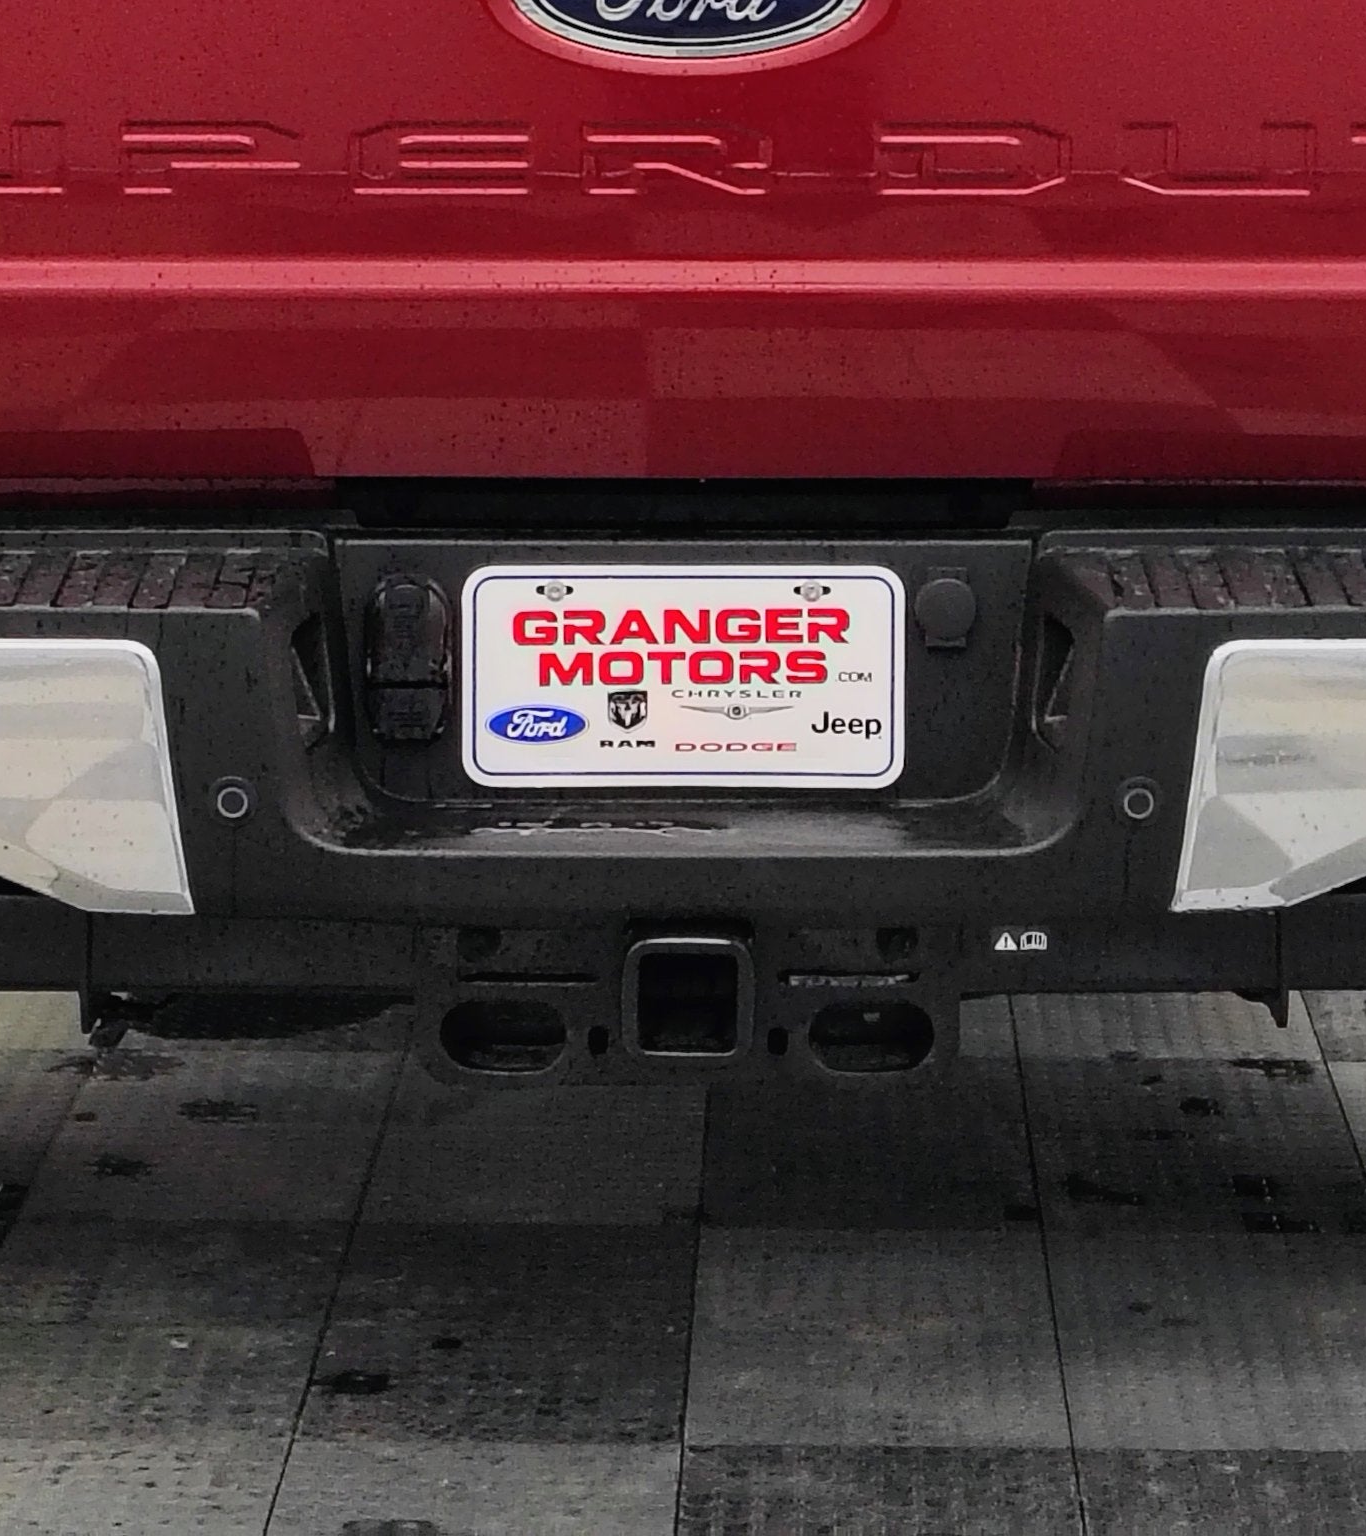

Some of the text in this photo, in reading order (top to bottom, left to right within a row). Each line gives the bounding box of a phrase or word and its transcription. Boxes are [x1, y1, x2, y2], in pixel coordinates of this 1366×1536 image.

[512, 609, 849, 645] GRANGER
[539, 651, 827, 686] MOTORS
[671, 689, 803, 699] CHRYSLER
[506, 709, 565, 738] Ford
[811, 711, 882, 739] Jeep
[600, 739, 655, 749] RAM
[675, 743, 797, 752] DODGE
